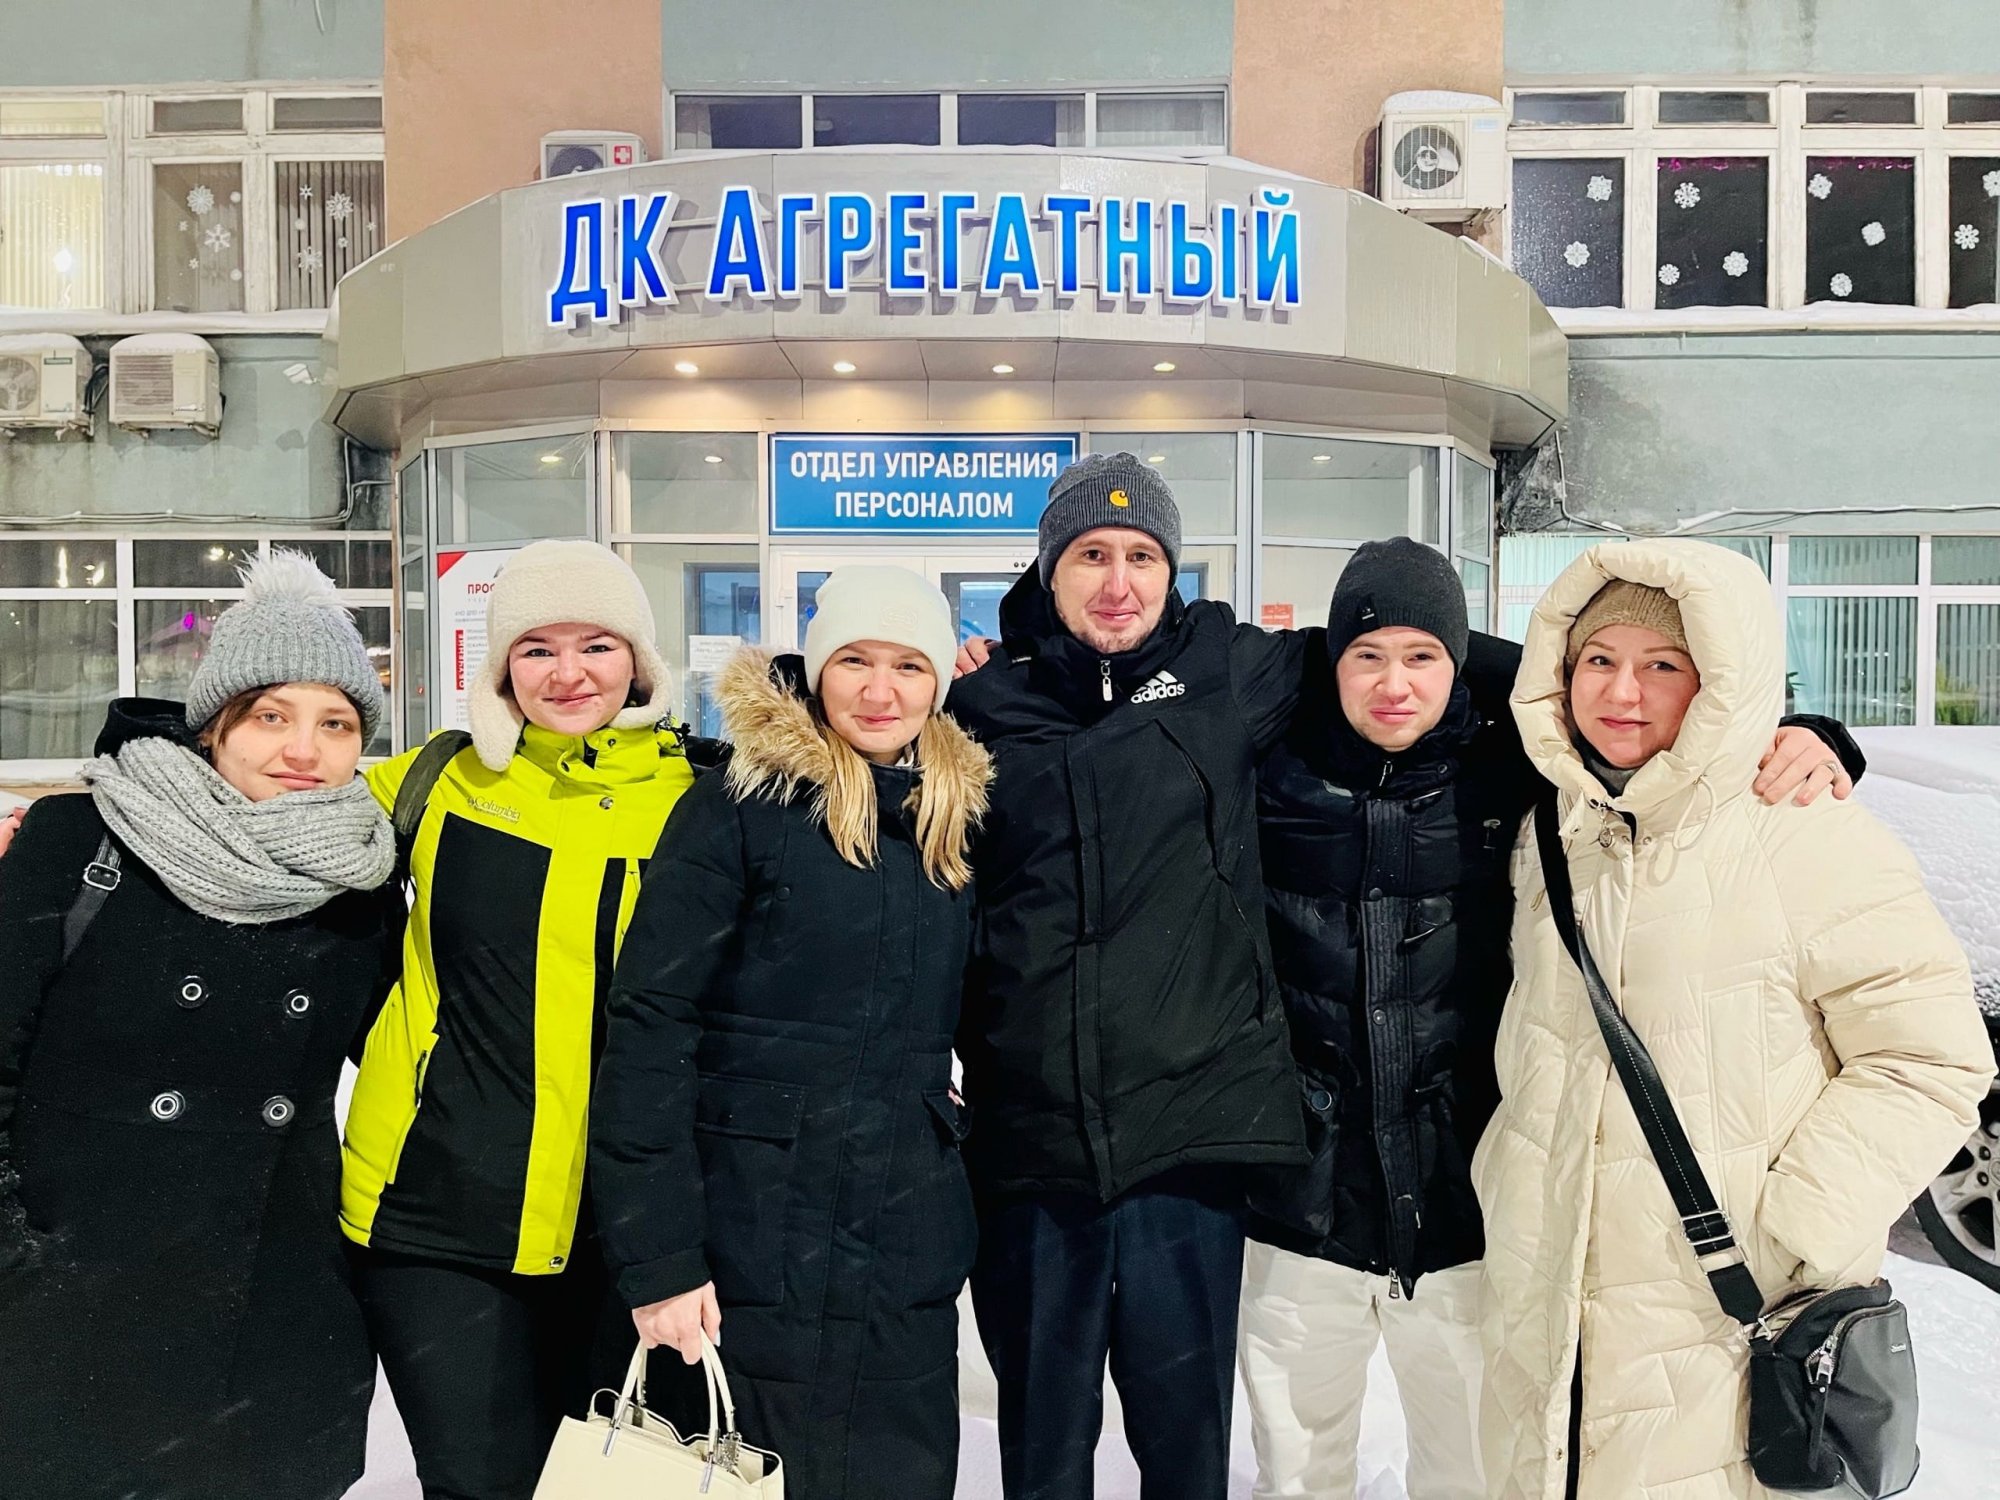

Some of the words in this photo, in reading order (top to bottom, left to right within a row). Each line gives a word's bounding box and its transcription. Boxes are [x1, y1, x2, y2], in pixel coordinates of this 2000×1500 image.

[545, 191, 672, 328] ДК
[790, 451, 875, 482] ОТДЕЛ
[884, 452, 1058, 478] УПРАВЛЕНИЯ
[835, 492, 1013, 518] ПЕРСОНАЛОМ
[1130, 683, 1186, 704] adidas
[474, 796, 521, 820] Columbia
